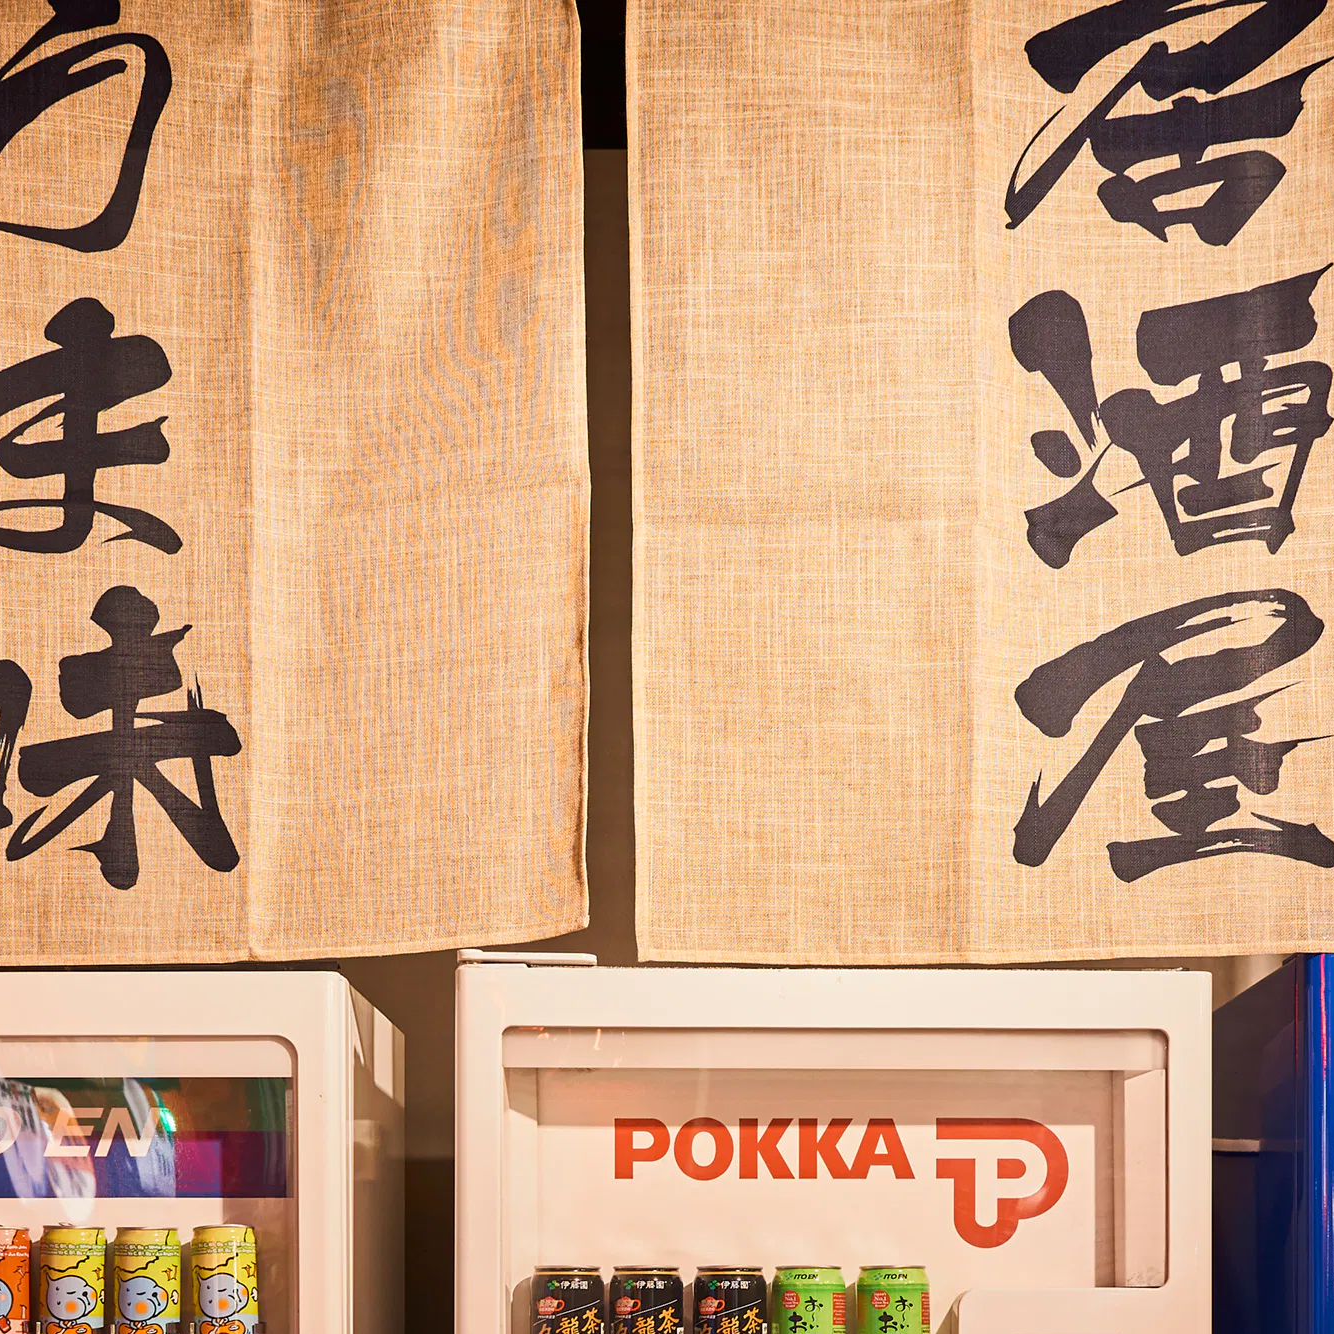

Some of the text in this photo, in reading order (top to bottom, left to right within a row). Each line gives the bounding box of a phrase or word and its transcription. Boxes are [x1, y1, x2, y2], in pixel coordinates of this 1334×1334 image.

[42, 1105, 165, 1159] EN
[613, 1118, 916, 1181] POKKA
[561, 1279, 589, 1290] 伊藤園
[636, 1279, 666, 1290] 伊藤園
